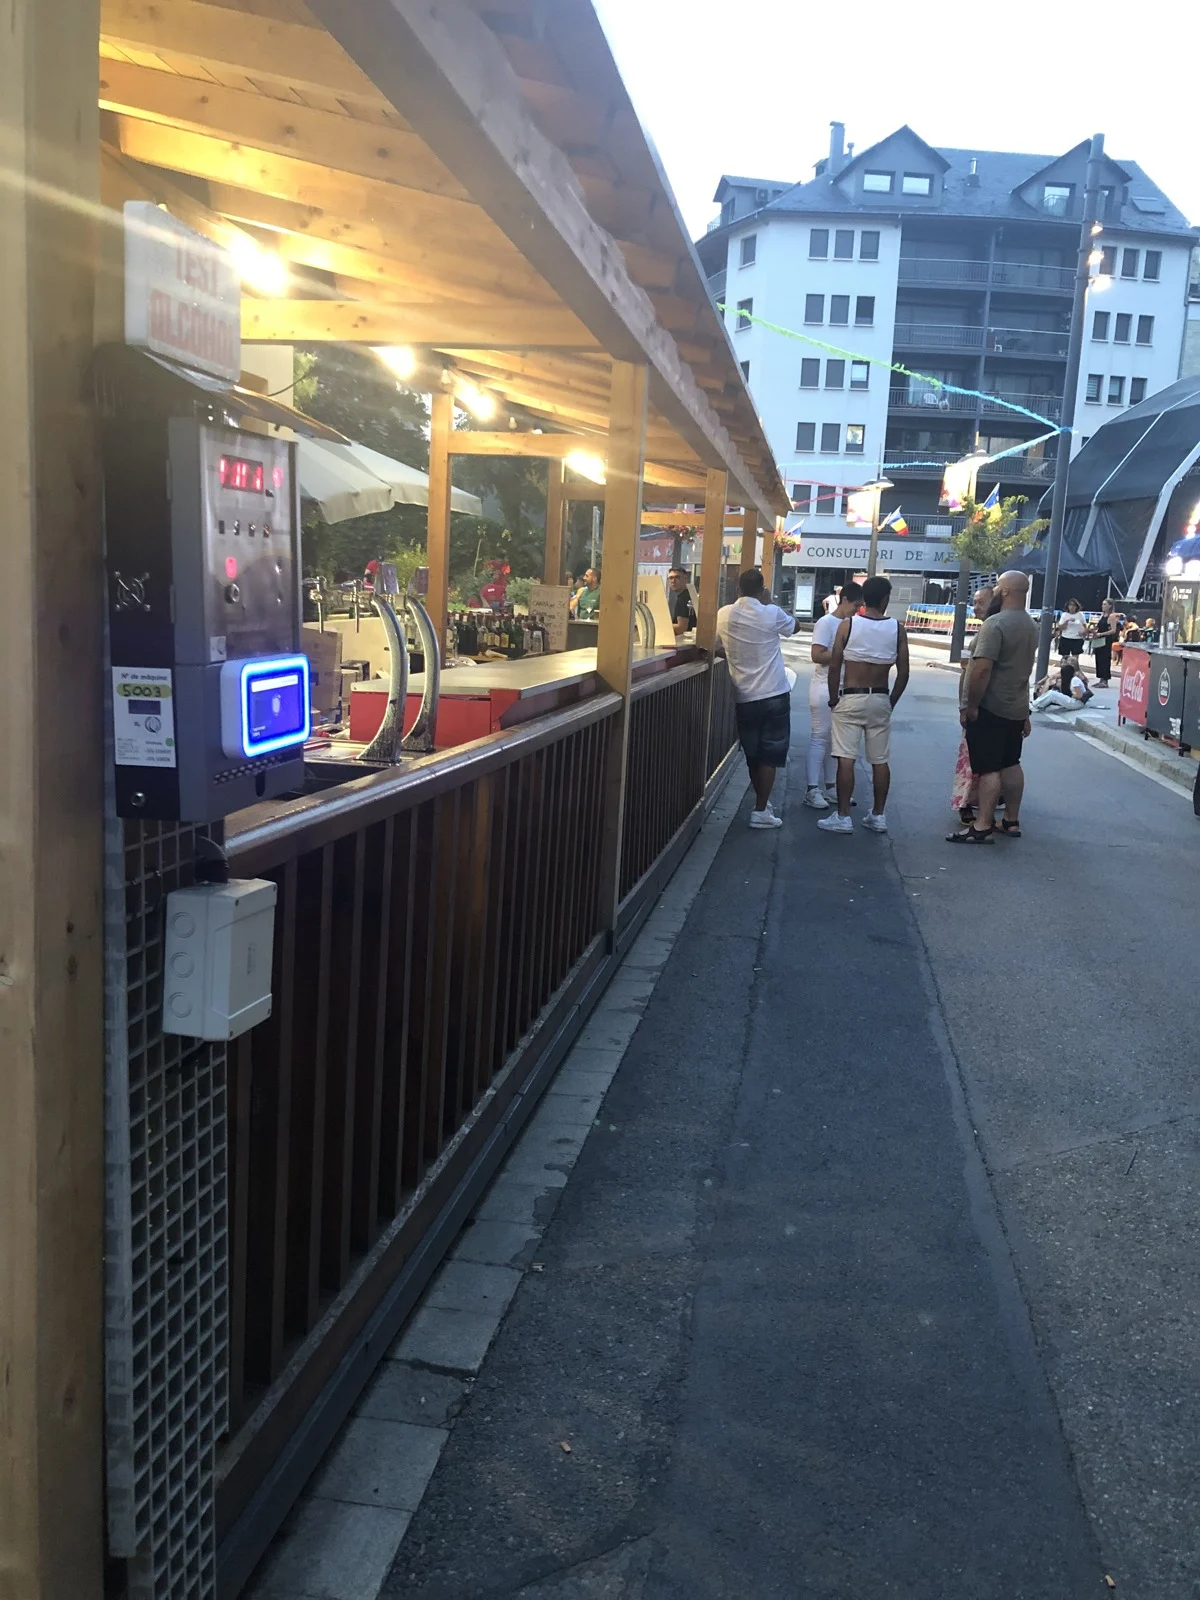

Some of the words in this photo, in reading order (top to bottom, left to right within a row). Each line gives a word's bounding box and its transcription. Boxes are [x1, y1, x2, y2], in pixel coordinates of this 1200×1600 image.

[905, 550, 924, 561] DE
[140, 673, 168, 682] máquina
[122, 684, 162, 697] 5003
